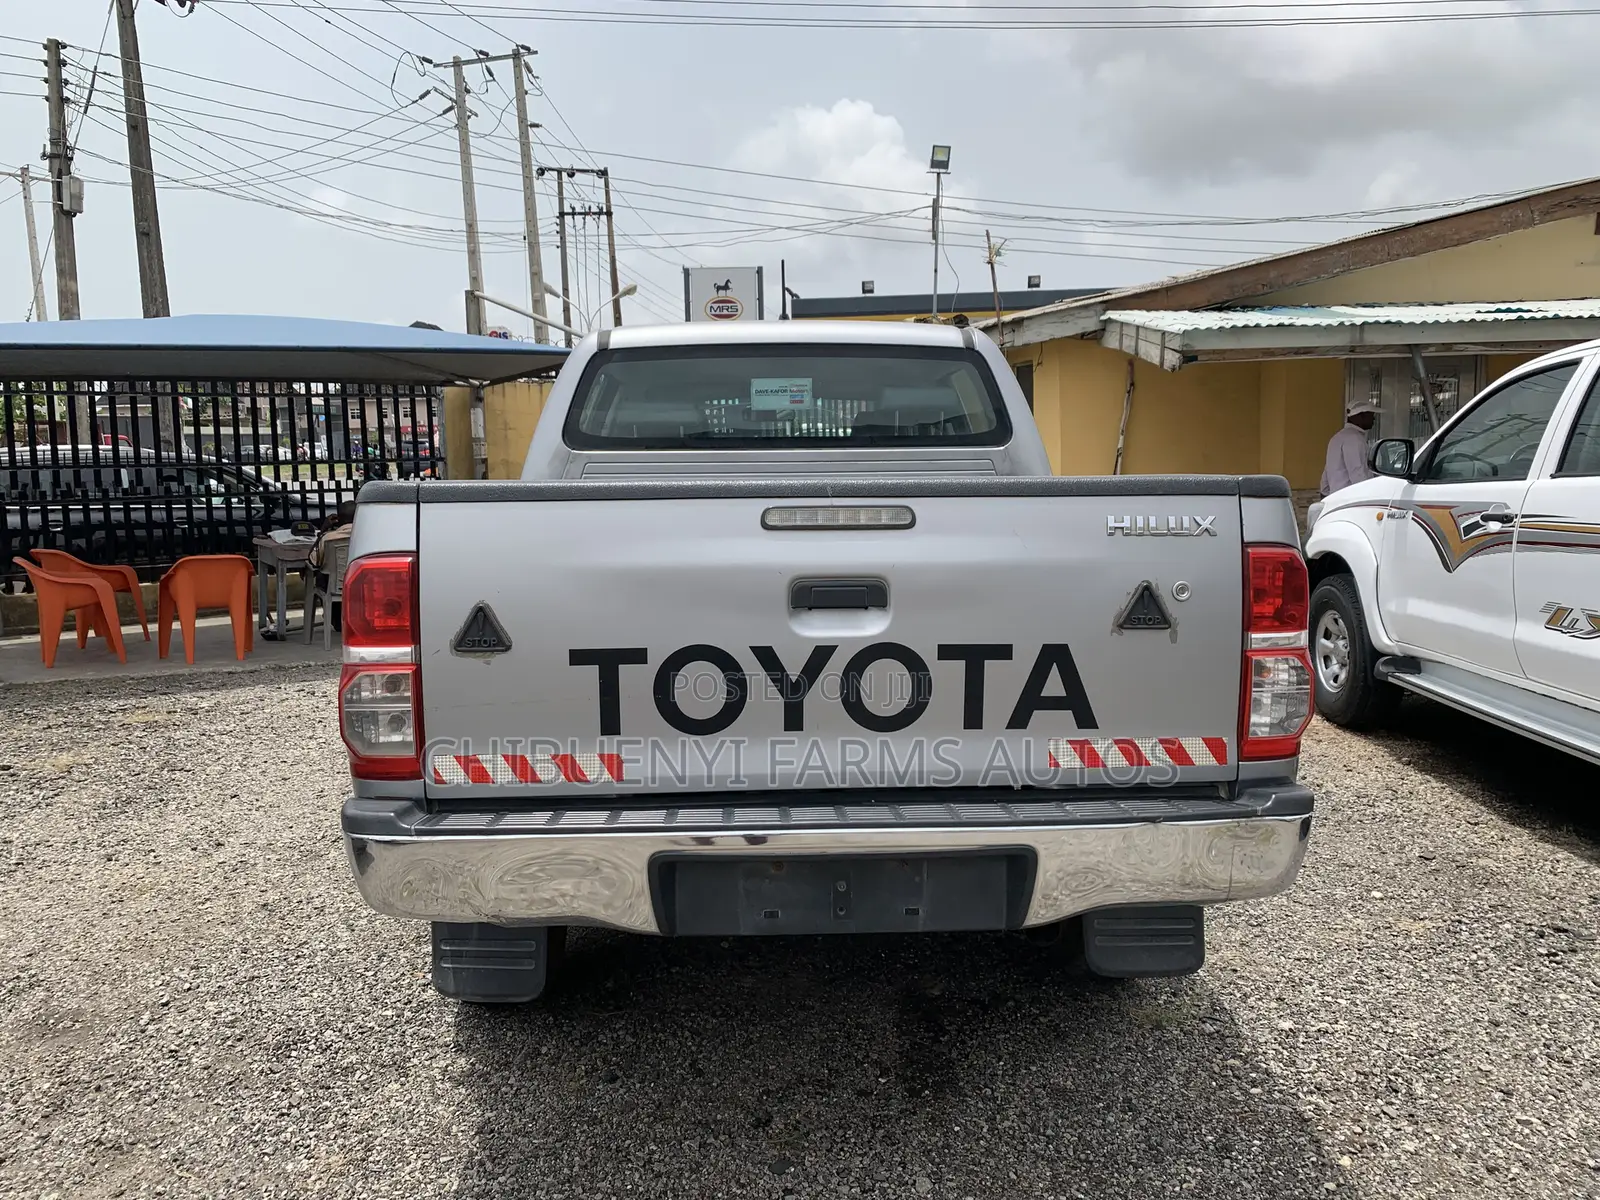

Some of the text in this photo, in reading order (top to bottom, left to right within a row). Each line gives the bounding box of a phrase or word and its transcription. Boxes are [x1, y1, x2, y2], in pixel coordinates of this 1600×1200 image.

[709, 305, 739, 313] MRS
[1106, 515, 1218, 537] HILUX
[1131, 615, 1162, 625] STOP
[464, 637, 498, 648] STOP
[568, 642, 1100, 737] TOYOTA
